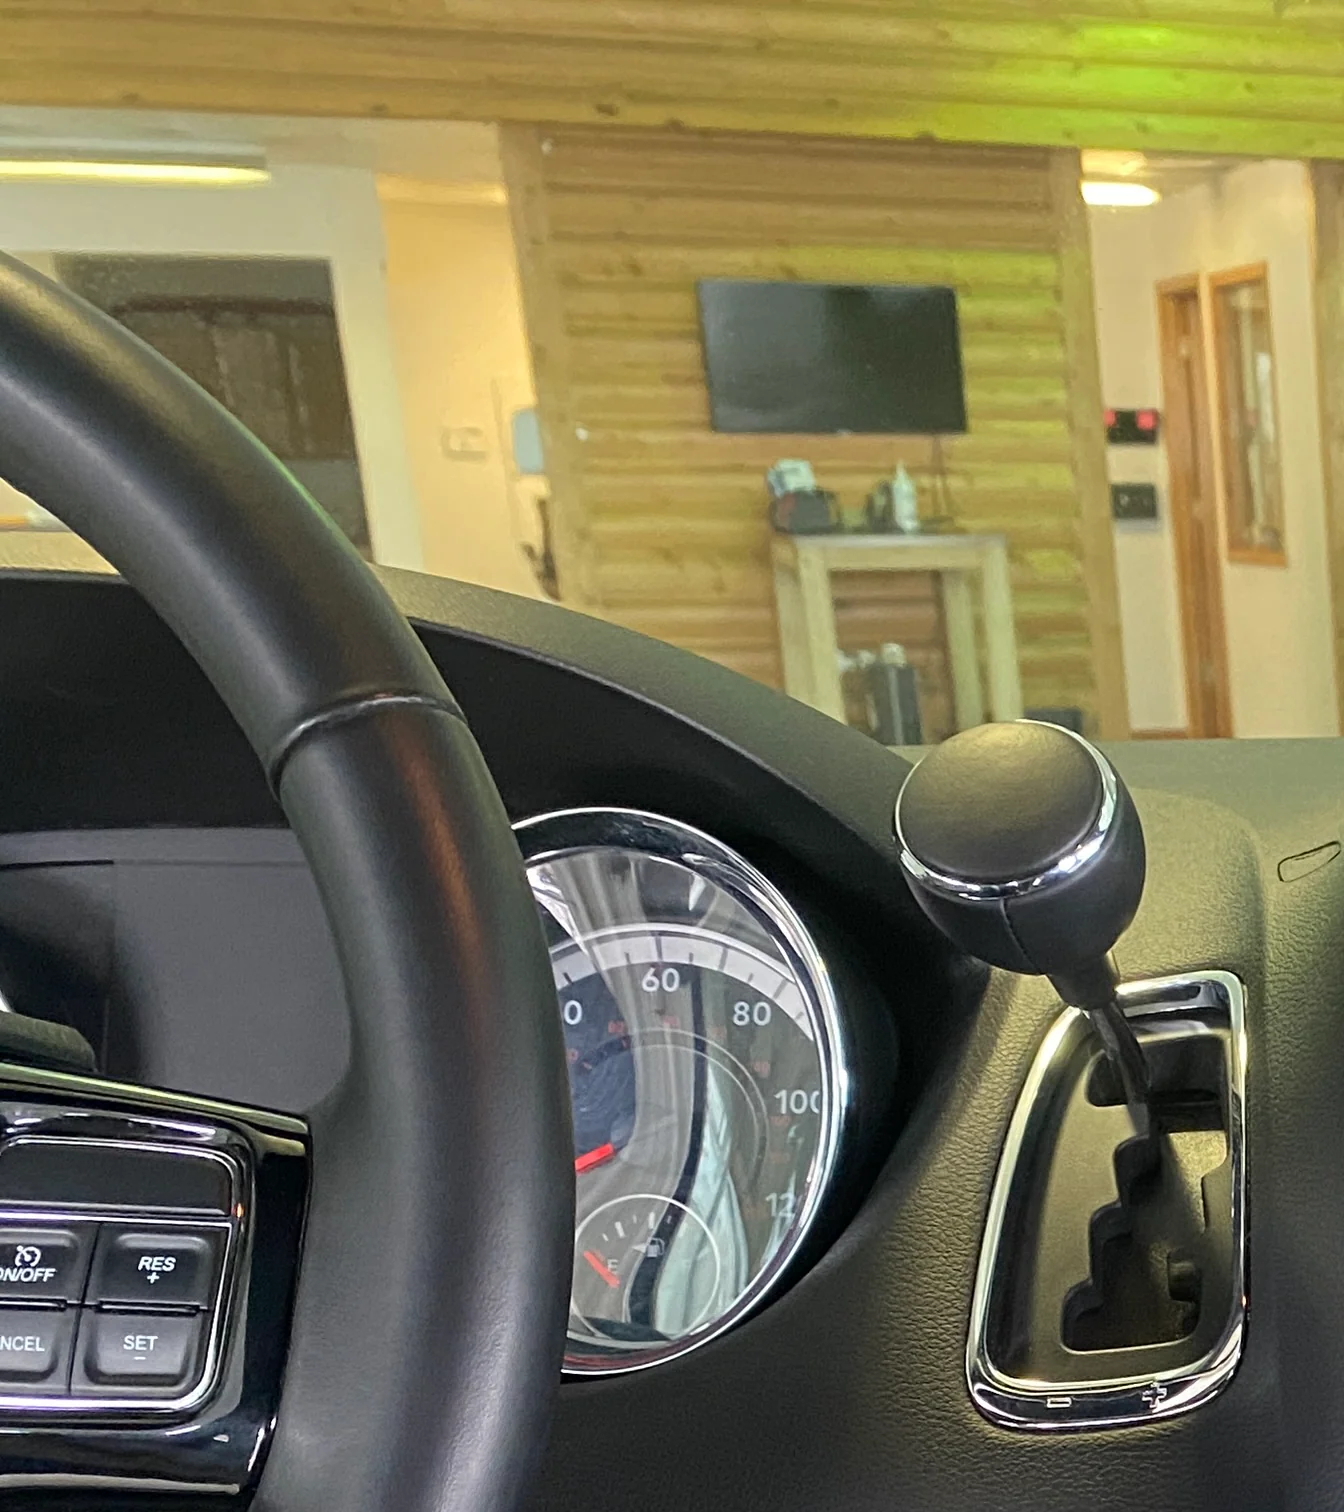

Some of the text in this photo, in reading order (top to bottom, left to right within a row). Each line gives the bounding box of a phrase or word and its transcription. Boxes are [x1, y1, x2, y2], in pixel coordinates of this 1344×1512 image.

[641, 967, 680, 993] 60
[732, 1001, 772, 1026] 80
[138, 1256, 176, 1271] RES
[0, 1335, 46, 1352] NCEL
[122, 1334, 159, 1351] SET
